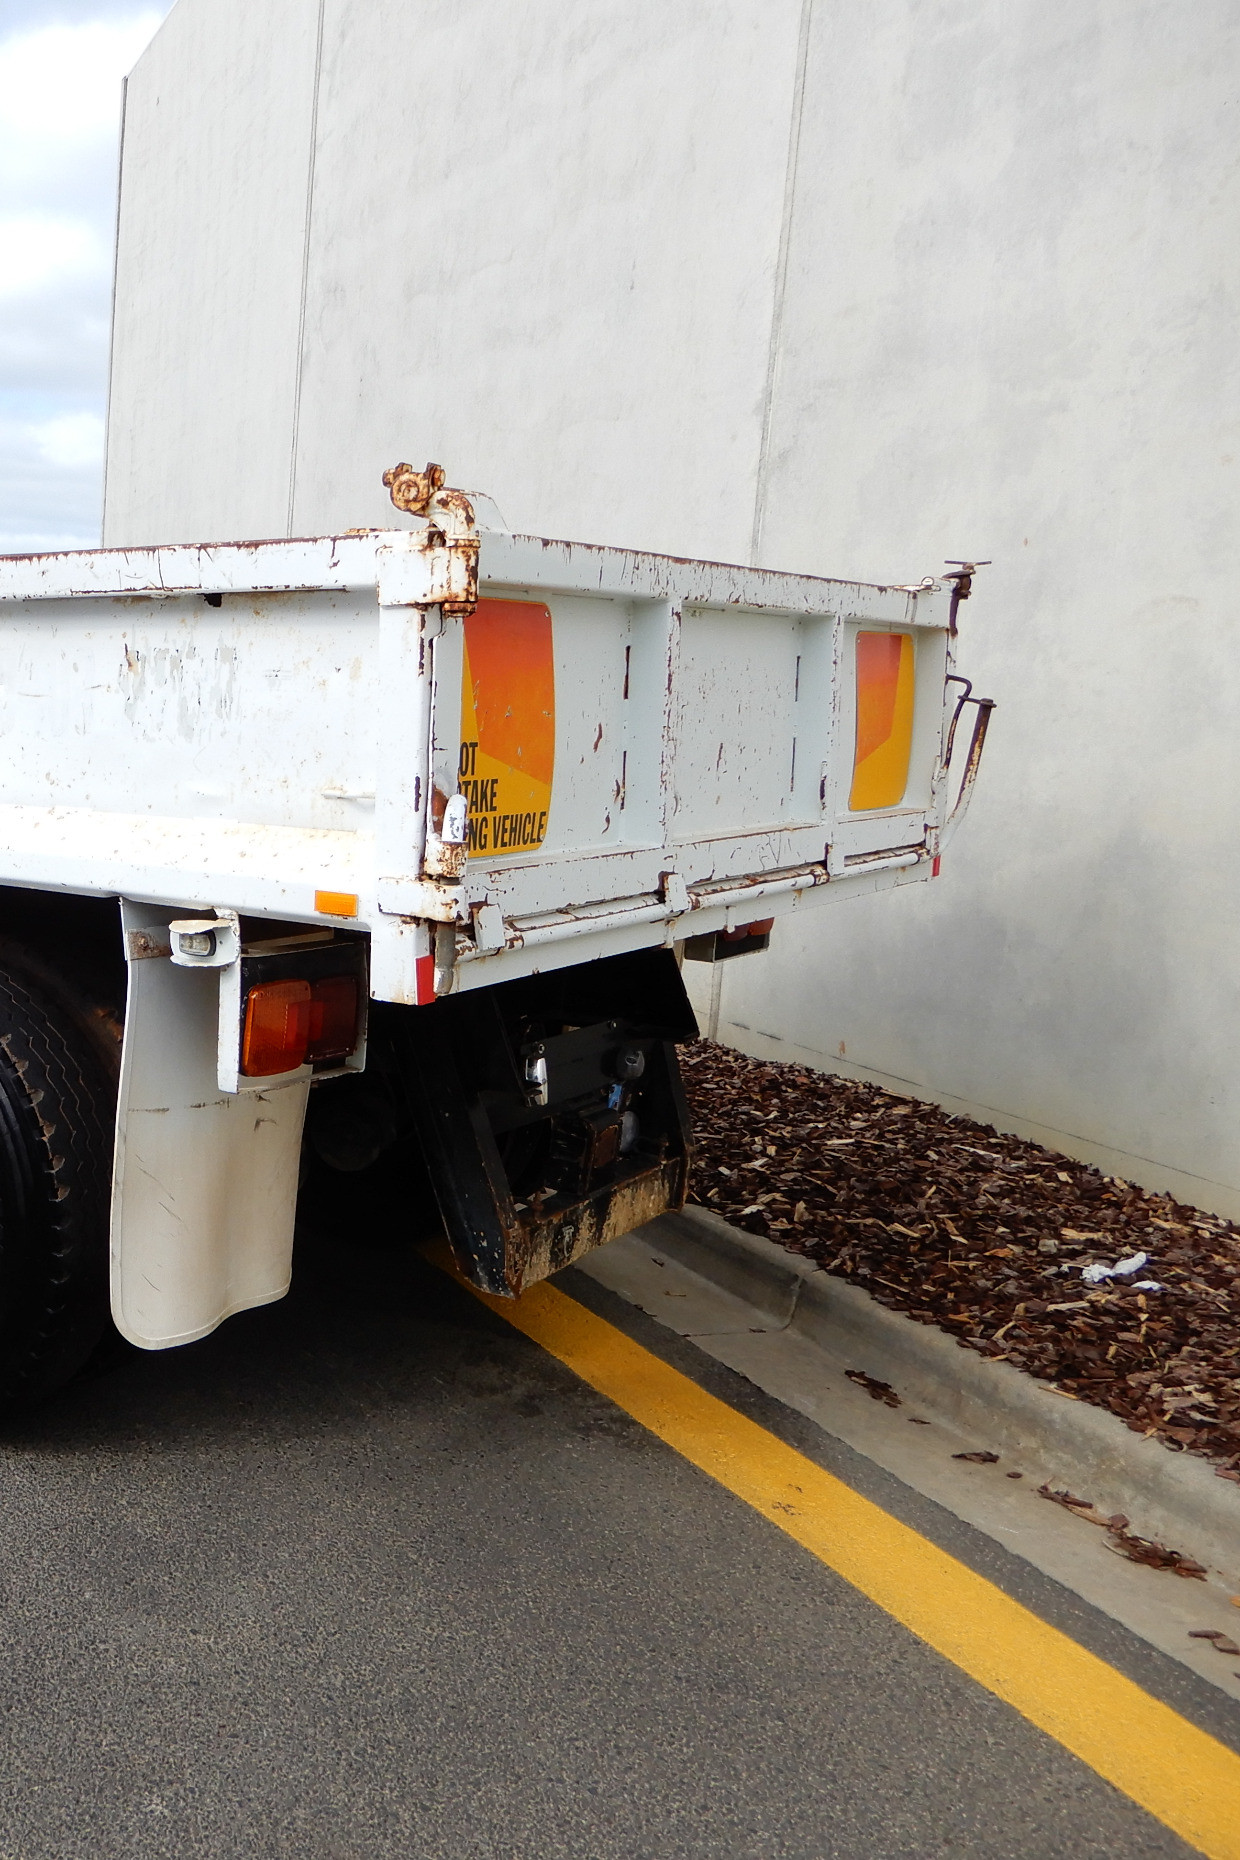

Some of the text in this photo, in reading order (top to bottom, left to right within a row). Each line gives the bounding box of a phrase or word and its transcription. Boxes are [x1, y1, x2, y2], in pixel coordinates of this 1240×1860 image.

[459, 741, 479, 777] OT
[459, 778, 498, 814] TAKE
[467, 811, 547, 851] NG VEHICLE
